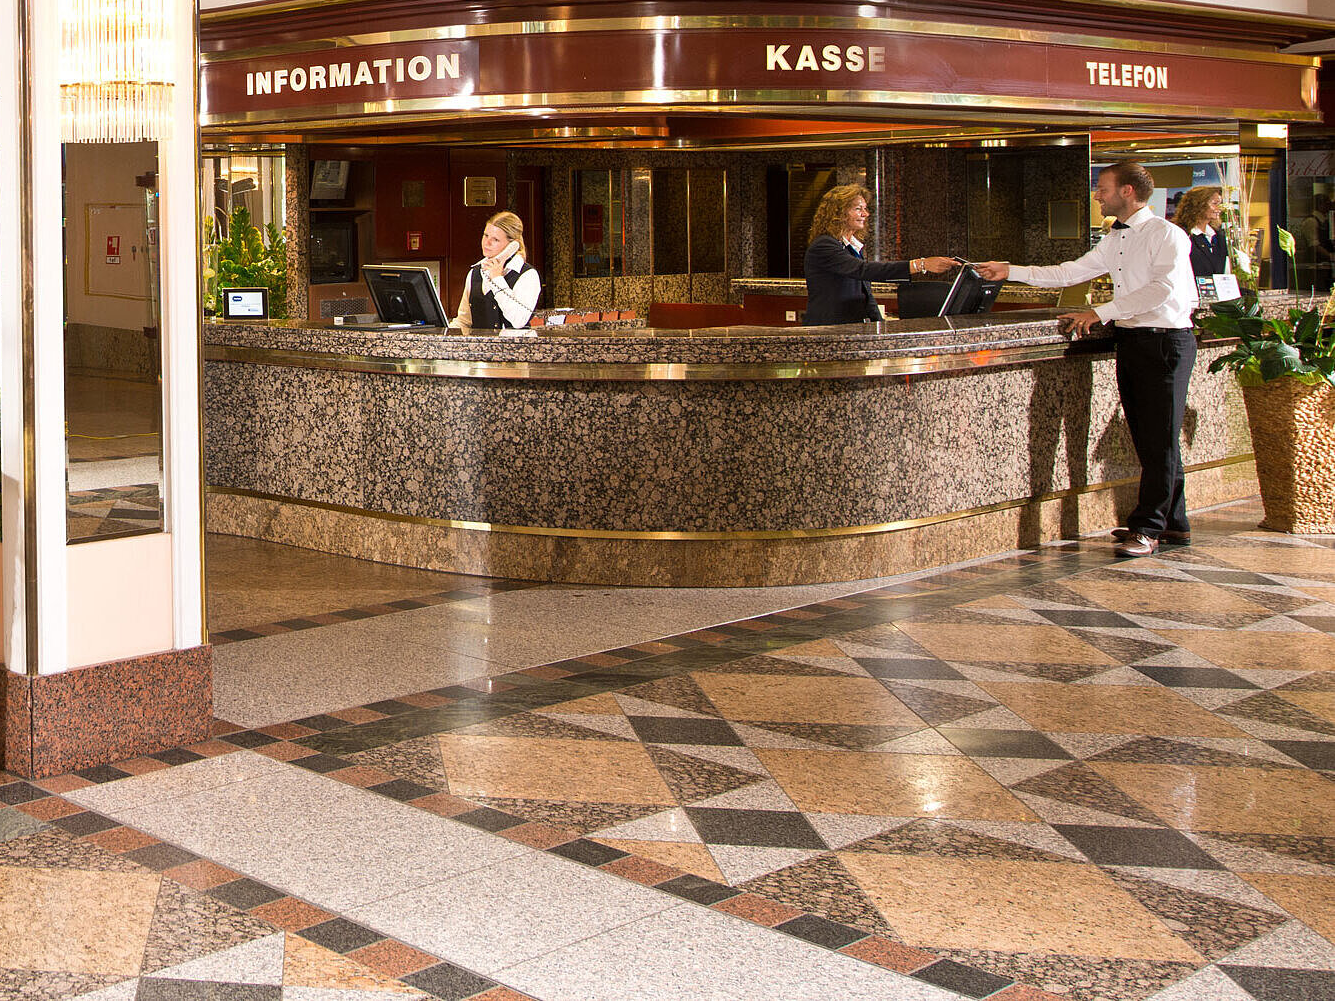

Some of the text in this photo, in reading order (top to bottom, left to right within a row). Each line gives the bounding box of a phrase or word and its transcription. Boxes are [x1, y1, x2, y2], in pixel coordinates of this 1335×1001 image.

[766, 44, 886, 72] KASSE
[246, 53, 460, 96] INFORMATION
[1086, 61, 1168, 89] TELEFON
